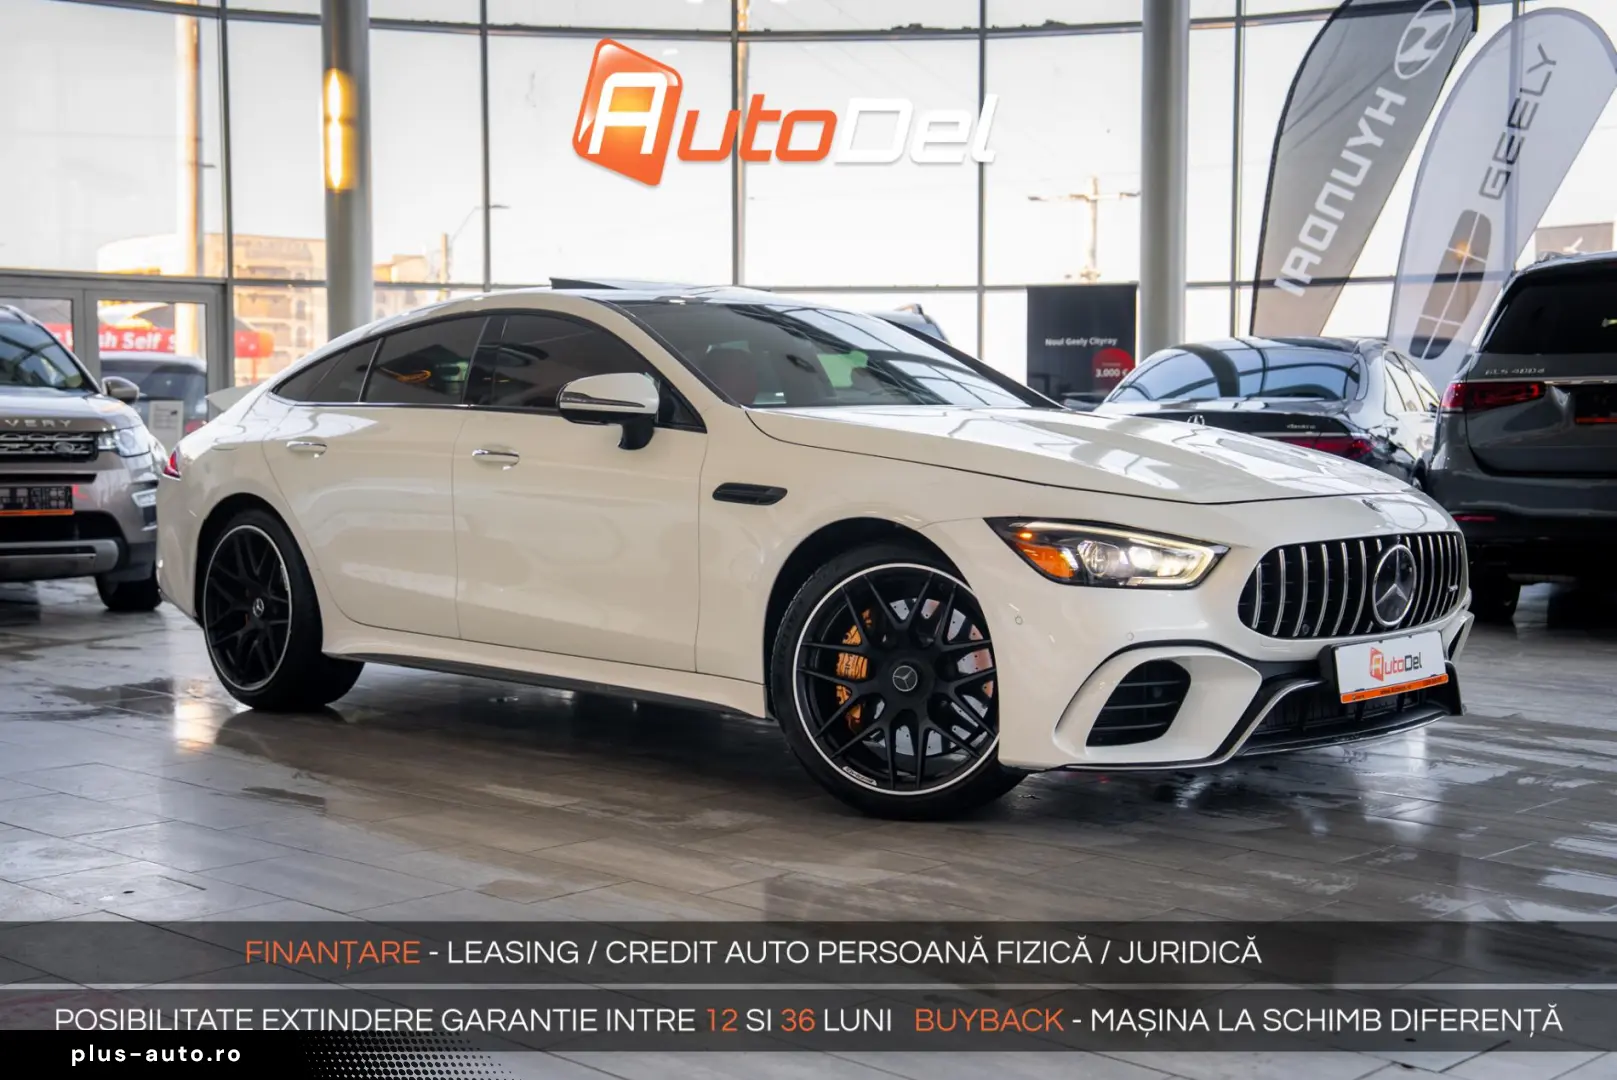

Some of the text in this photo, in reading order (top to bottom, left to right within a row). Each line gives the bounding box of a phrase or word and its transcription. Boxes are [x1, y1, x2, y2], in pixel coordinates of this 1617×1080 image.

[1477, 43, 1557, 200] GEELY
[122, 332, 162, 349] Self
[1066, 338, 1088, 347] Geely
[1371, 651, 1423, 677] AutoDel
